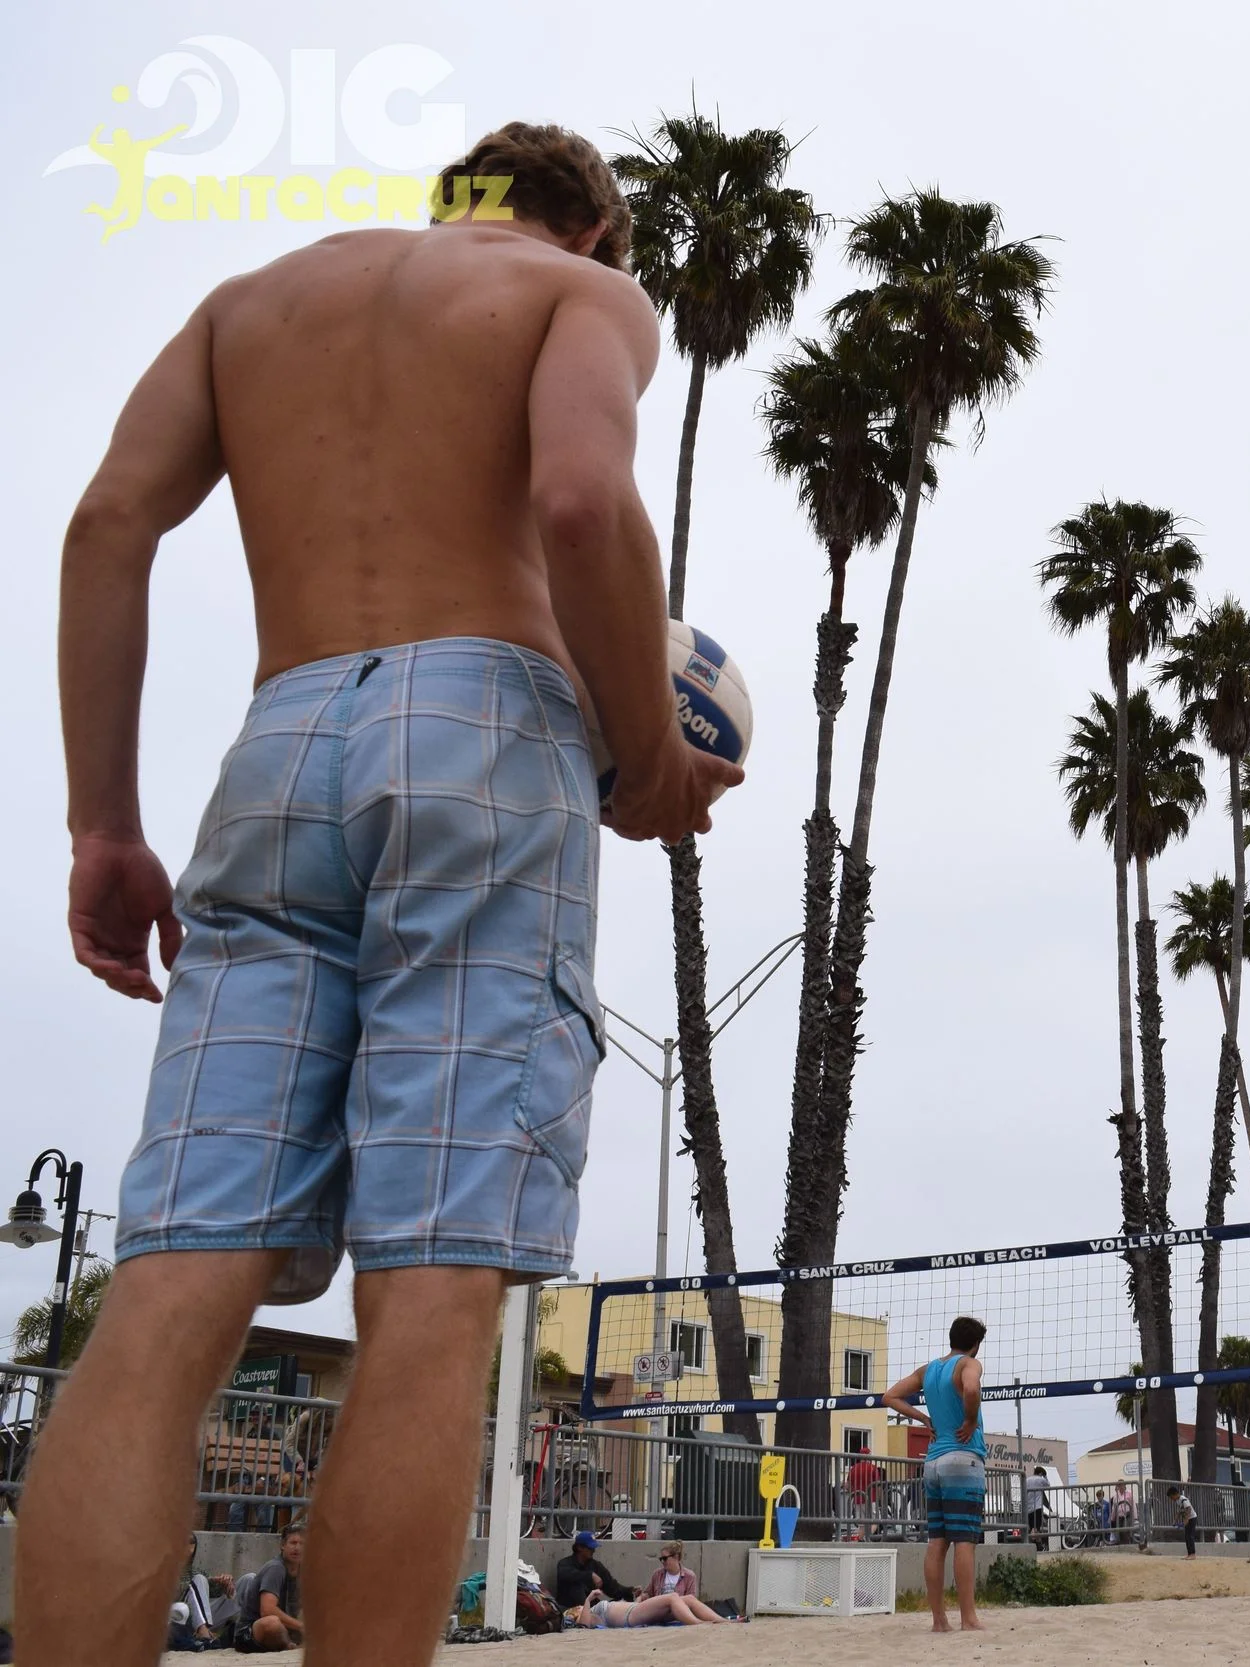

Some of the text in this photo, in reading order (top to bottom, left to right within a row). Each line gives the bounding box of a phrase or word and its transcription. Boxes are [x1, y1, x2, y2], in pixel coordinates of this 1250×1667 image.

[677, 692, 720, 748] lson
[931, 1229, 1214, 1269] MAIN BEACH VOLLEYBALL
[798, 1260, 896, 1281] SANTA CRUZ
[233, 1369, 279, 1386] Coastview
[622, 1402, 735, 1418] www.santacruzwharf.com
[994, 1443, 1033, 1463] Hermso
